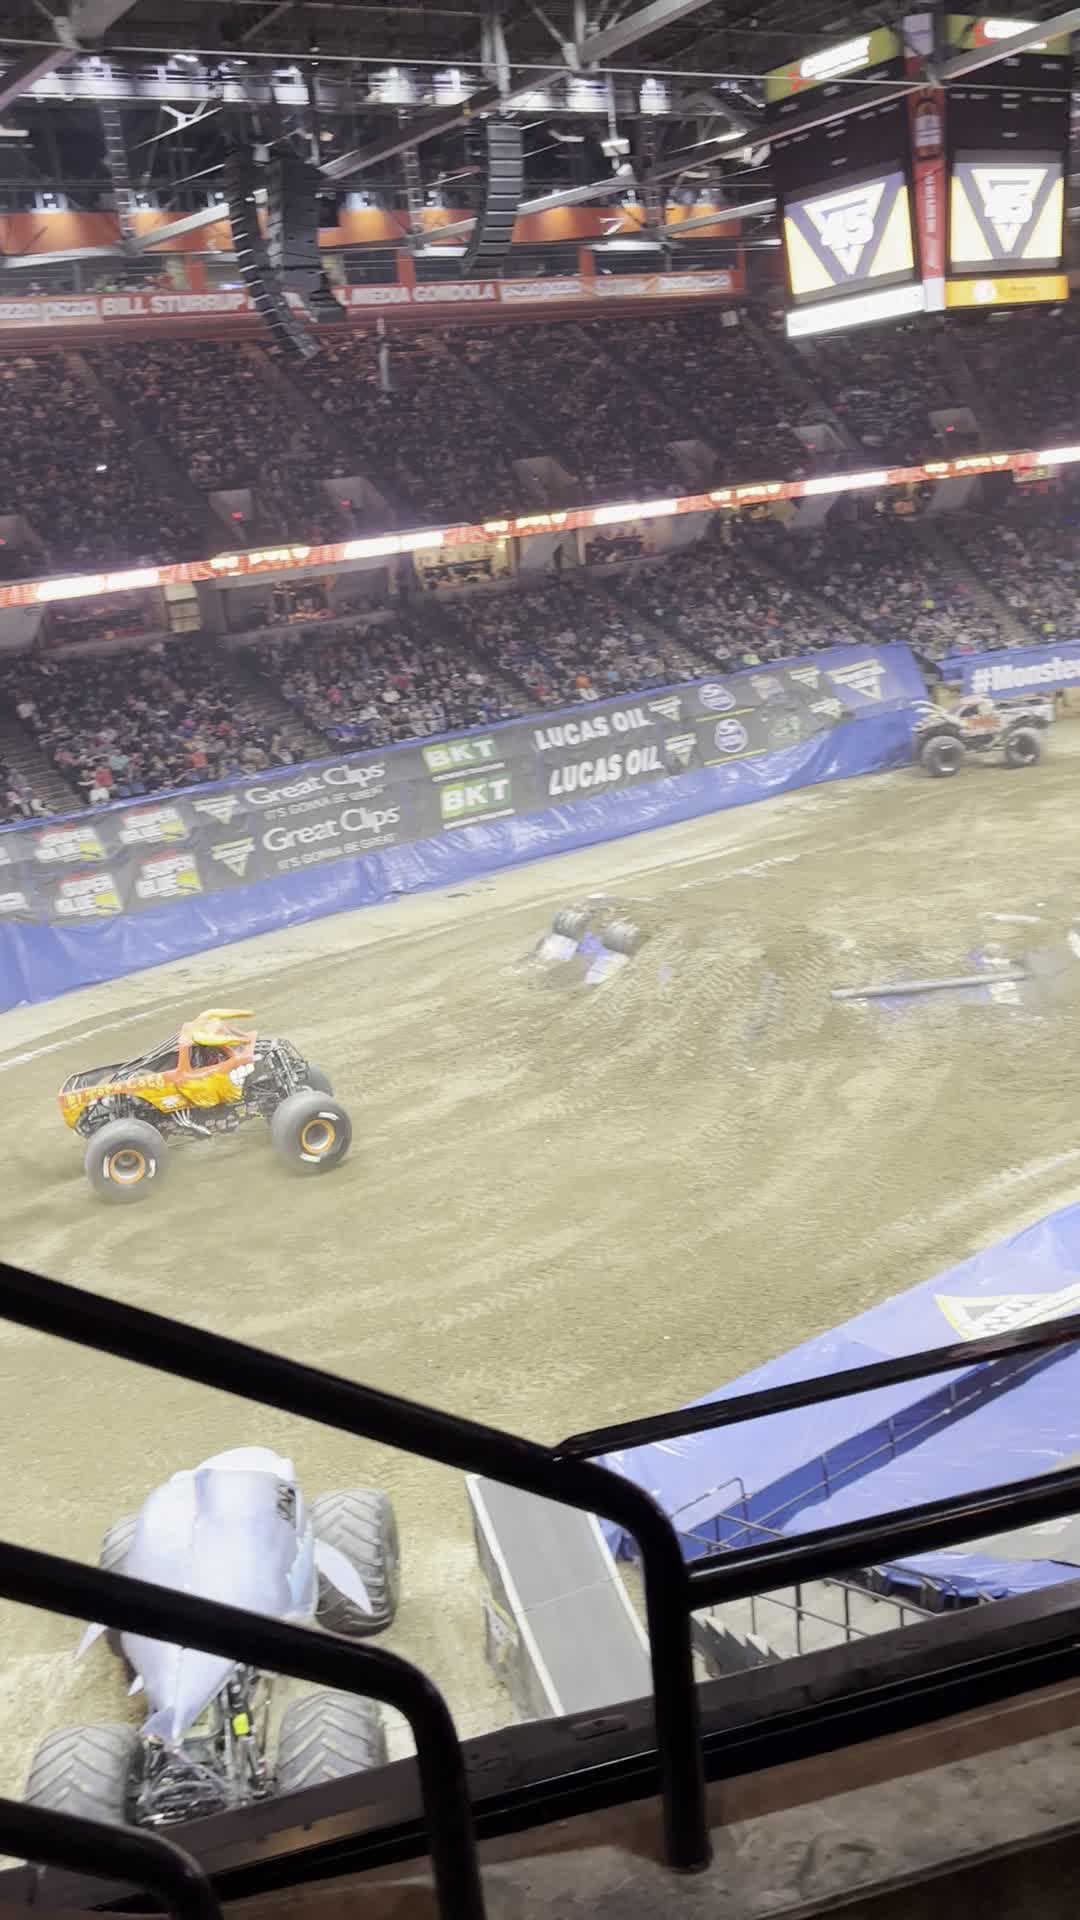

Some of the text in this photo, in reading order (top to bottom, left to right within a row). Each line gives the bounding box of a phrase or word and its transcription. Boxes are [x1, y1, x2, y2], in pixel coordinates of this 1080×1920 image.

[102, 297, 148, 315] BILL
[533, 707, 655, 751] LUCAS OIL
[424, 738, 494, 769] BKT
[548, 754, 625, 796] LUCAS
[626, 745, 664, 776] OIL
[245, 764, 386, 804] Great Clips
[442, 778, 510, 812] BKT
[262, 806, 400, 851] Great Clips
